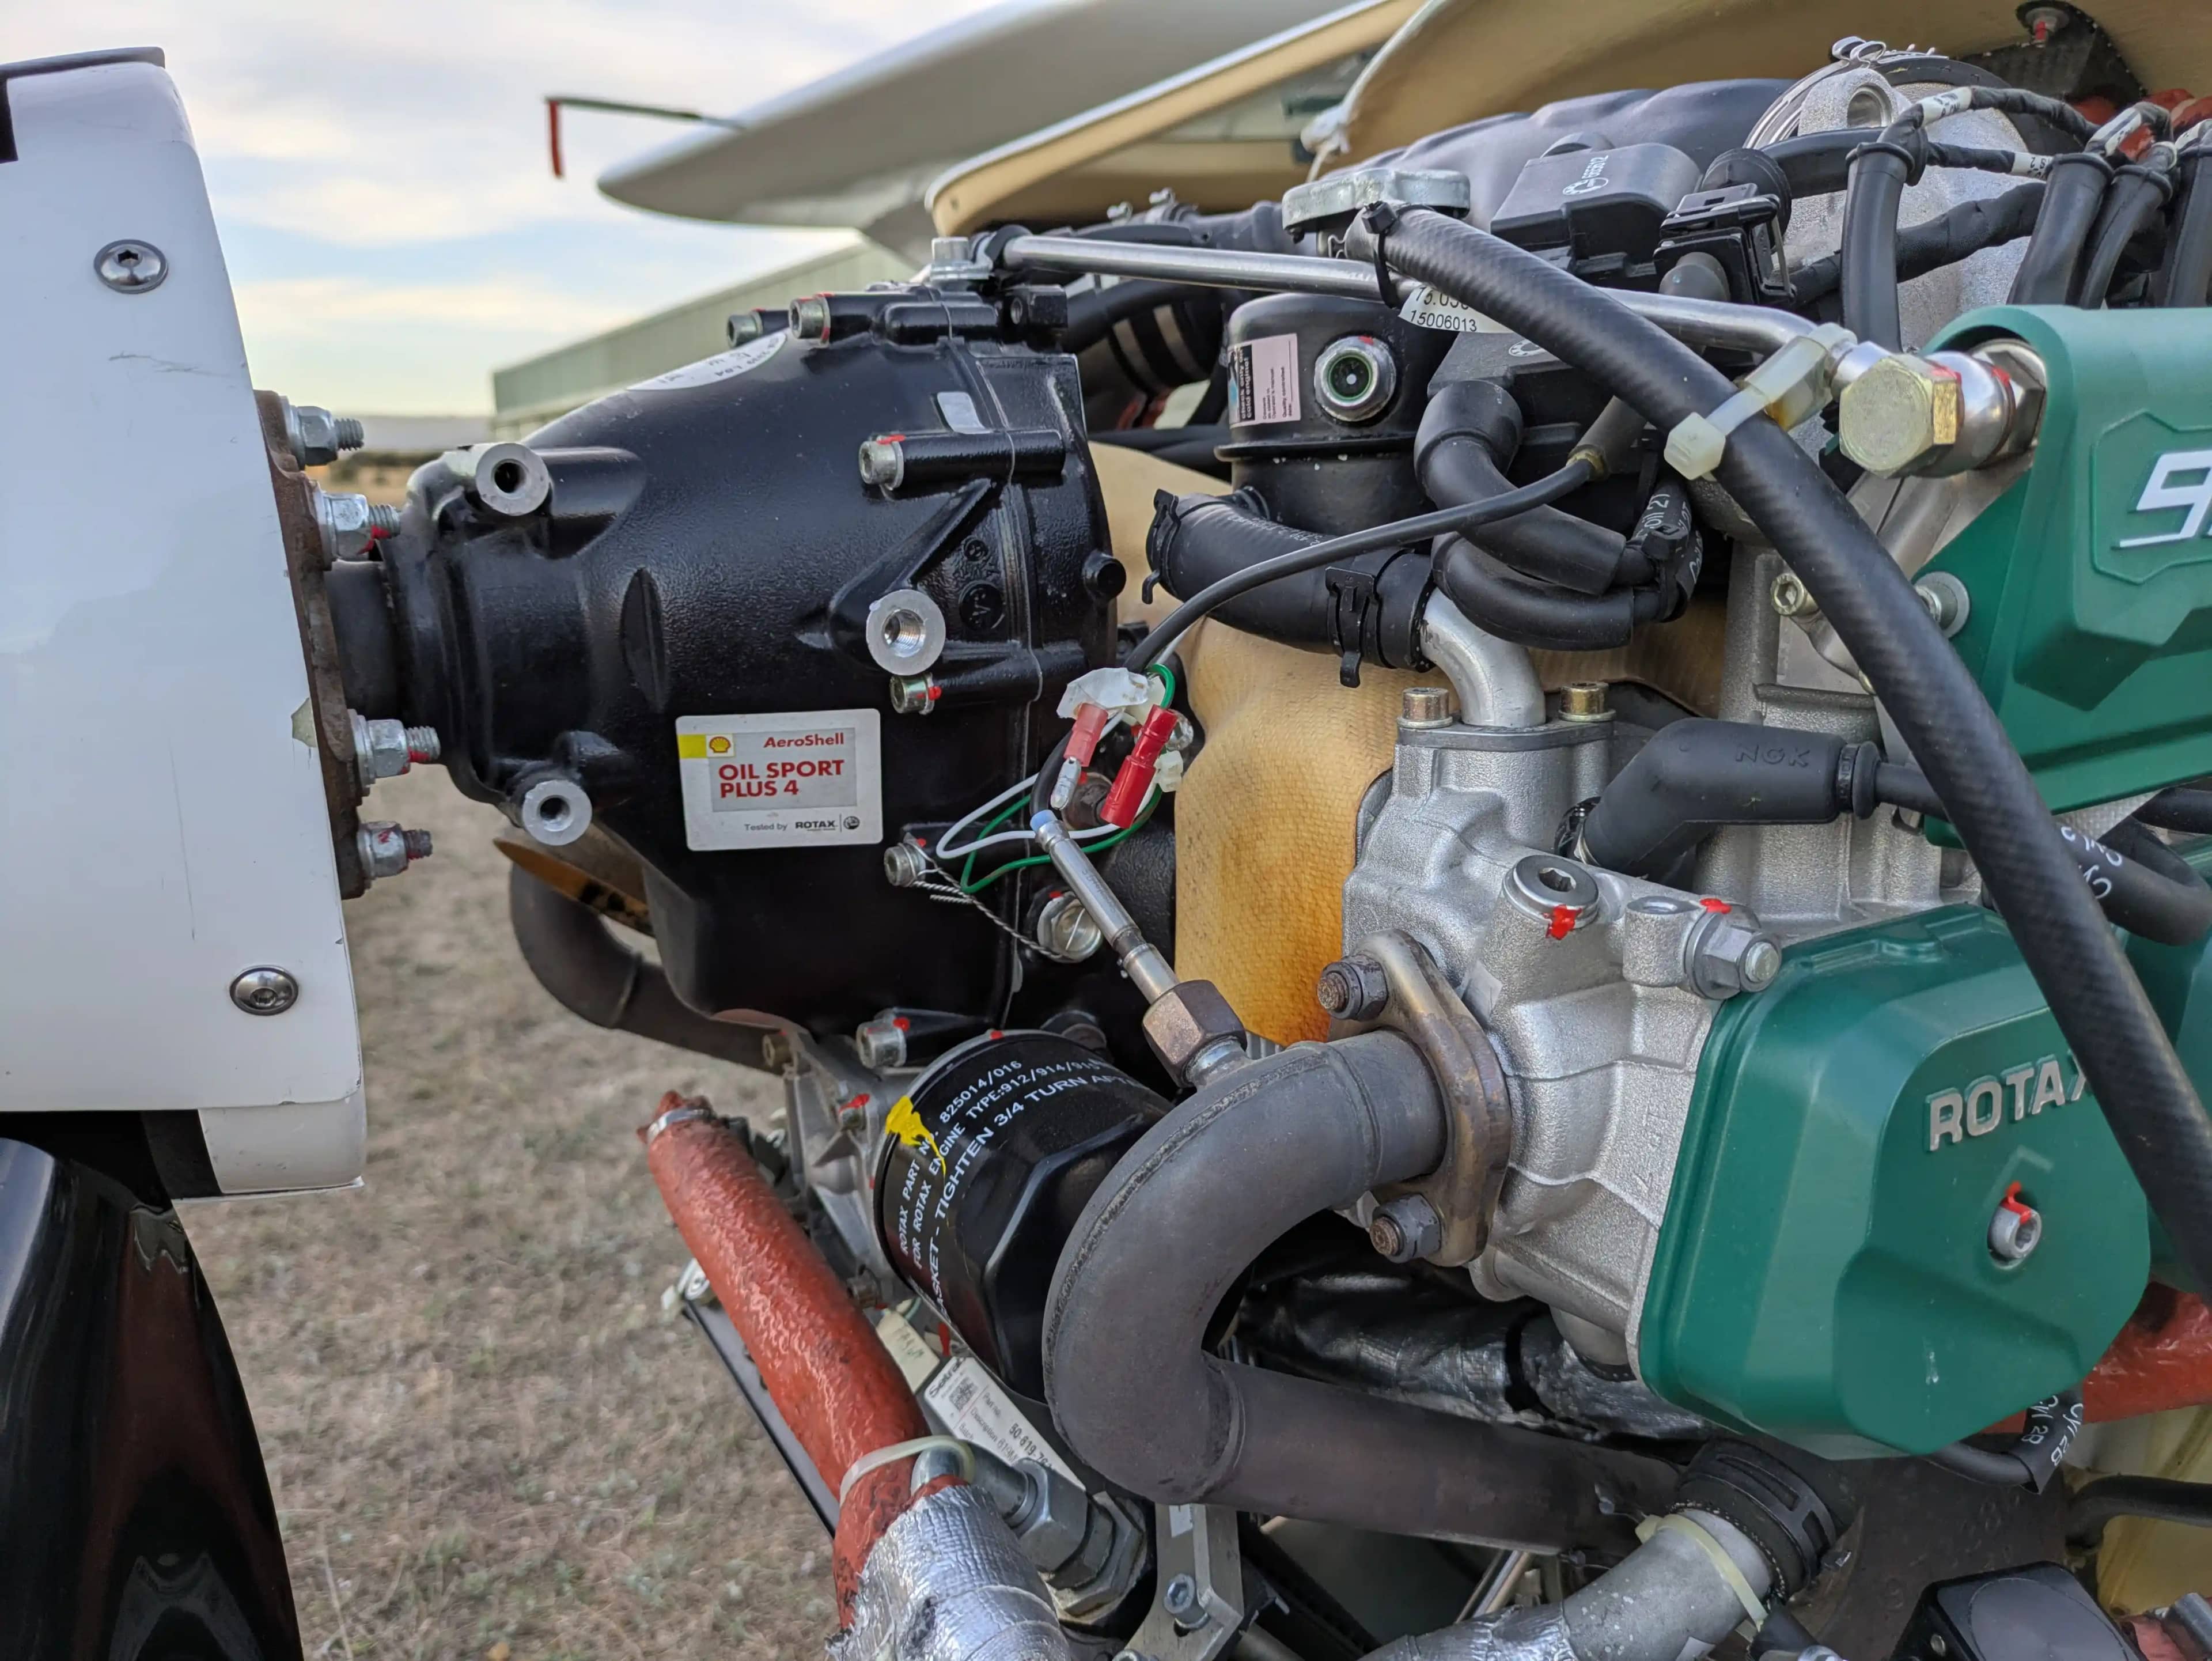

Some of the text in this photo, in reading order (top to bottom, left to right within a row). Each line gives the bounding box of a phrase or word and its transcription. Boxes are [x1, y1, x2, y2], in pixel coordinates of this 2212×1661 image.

[1411, 309, 1477, 332] 15006013
[2119, 449, 2212, 547] 9
[763, 732, 844, 748] AeroShell
[1735, 746, 1812, 768] NGK
[719, 759, 844, 780] OIL SPORT
[720, 780, 799, 798] PLUS 4
[745, 820, 836, 831] Tested by ROTAX
[940, 1061, 1022, 1123] 825014/016
[929, 1122, 965, 1175] ENGINE
[934, 1126, 995, 1219] TIGHTEN
[994, 1101, 1025, 1127] 3/4
[1024, 1076, 1088, 1102] TURN
[902, 1158, 921, 1201] PART
[912, 1179, 931, 1233] ROTAX
[898, 1205, 909, 1257] ROTAX
[912, 1236, 922, 1270] FOR
[982, 1392, 994, 1409] Part
